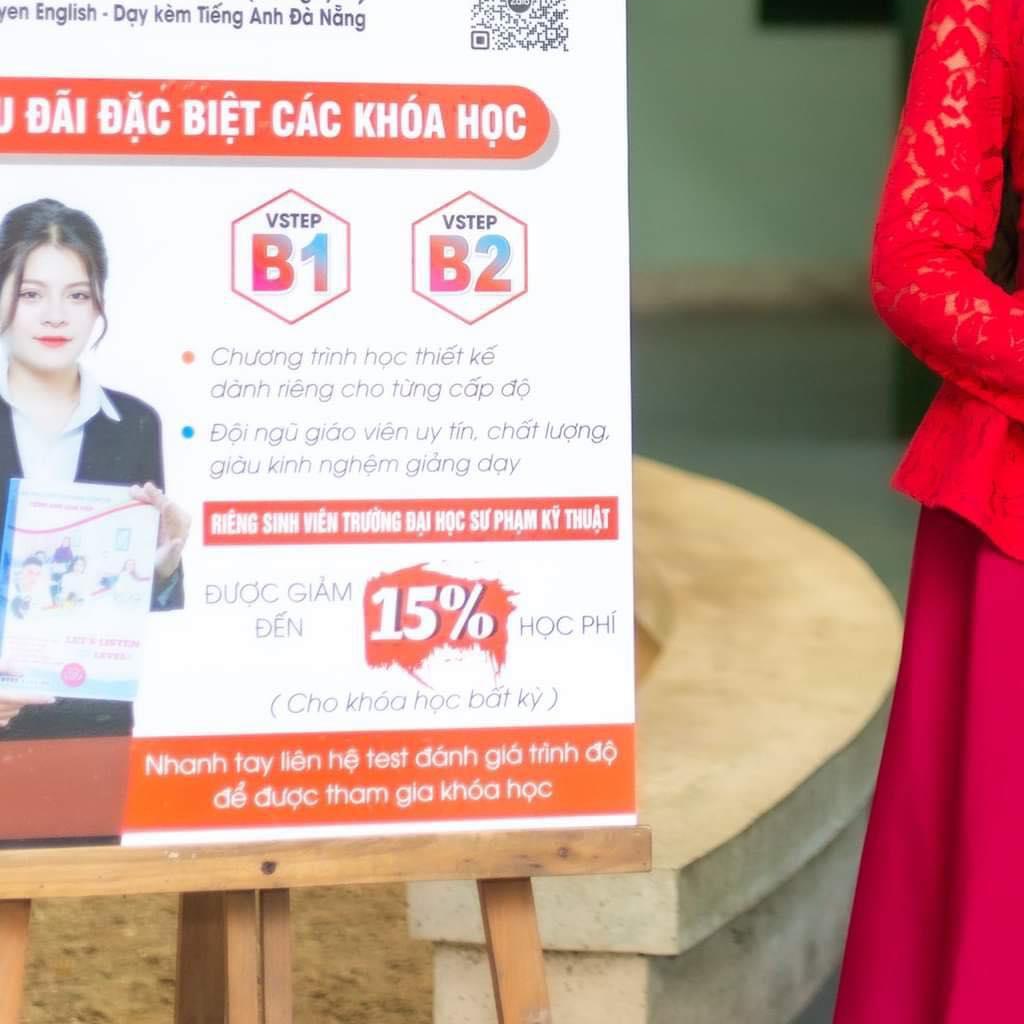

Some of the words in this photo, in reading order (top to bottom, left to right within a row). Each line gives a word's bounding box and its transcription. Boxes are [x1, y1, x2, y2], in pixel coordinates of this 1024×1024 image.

[36, 2, 97, 26] English
[114, 4, 148, 27] Dạy
[154, 4, 191, 24] kèm
[197, 2, 243, 29] Tiếng
[250, 7, 283, 25] Anh
[289, 6, 313, 26] Đà
[320, 5, 366, 32] Nẵng
[25, 88, 86, 134] ĐÃI
[97, 90, 171, 144] ĐẶC
[183, 90, 261, 145] BIỆT
[272, 92, 342, 138] CÁC
[354, 93, 446, 139] KHÓA
[457, 103, 527, 148] HỌC
[265, 213, 322, 228] VSTEP
[442, 214, 498, 230] VSTEP
[252, 233, 329, 292] B1
[429, 234, 512, 292] B2
[210, 347, 303, 370] Chương
[311, 347, 357, 366] trình
[364, 347, 408, 370] học
[415, 344, 464, 366] thiết
[470, 344, 498, 366] kế
[210, 379, 271, 399] dành
[277, 379, 334, 403] riêng
[341, 380, 385, 398] cho
[392, 378, 442, 402] từng
[449, 376, 494, 401] cấp
[501, 378, 531, 401] độ
[210, 423, 248, 446] Đội
[254, 422, 298, 447] ngũ
[305, 422, 356, 446] giáo
[364, 422, 408, 441] viên
[416, 426, 442, 444] uy
[487, 418, 539, 441] chất
[544, 421, 610, 444] lượng,
[209, 456, 261, 480] giàu
[268, 456, 312, 474] kinh
[406, 452, 471, 477] giảng
[477, 454, 521, 476] dạy
[211, 508, 258, 535] RIÊNG
[263, 512, 299, 534] SINH
[304, 508, 339, 534] VIÊN
[342, 506, 402, 533] TRƯỜNG
[406, 510, 431, 537] ĐẠI
[435, 510, 465, 537] HỌC
[470, 508, 491, 532] SƯ
[493, 509, 537, 535] PHẠM
[542, 504, 560, 529] KỸ
[565, 504, 610, 534] THUẬT
[205, 581, 280, 608] ĐƯỢC
[287, 575, 352, 603] GIẢM
[256, 611, 303, 639] ĐẾN
[370, 581, 497, 641] 15%
[520, 614, 574, 640] HỌC
[581, 610, 617, 635] PHÍ
[287, 692, 338, 714] Cho
[345, 689, 407, 713] khóa
[414, 689, 460, 715] học
[468, 684, 511, 709] bất
[145, 752, 227, 776] Nhanh
[234, 752, 272, 776] tay
[280, 749, 321, 772] liên
[328, 747, 359, 774] hệ
[367, 747, 408, 769] test
[415, 745, 478, 768] đánh
[485, 743, 523, 771] giá
[529, 741, 579, 765] trình
[585, 740, 618, 766] độ
[212, 780, 247, 809] để
[254, 786, 318, 810] được
[326, 783, 390, 806] tham
[395, 782, 434, 808] gia
[440, 777, 500, 802] khóa
[507, 778, 553, 804] học
